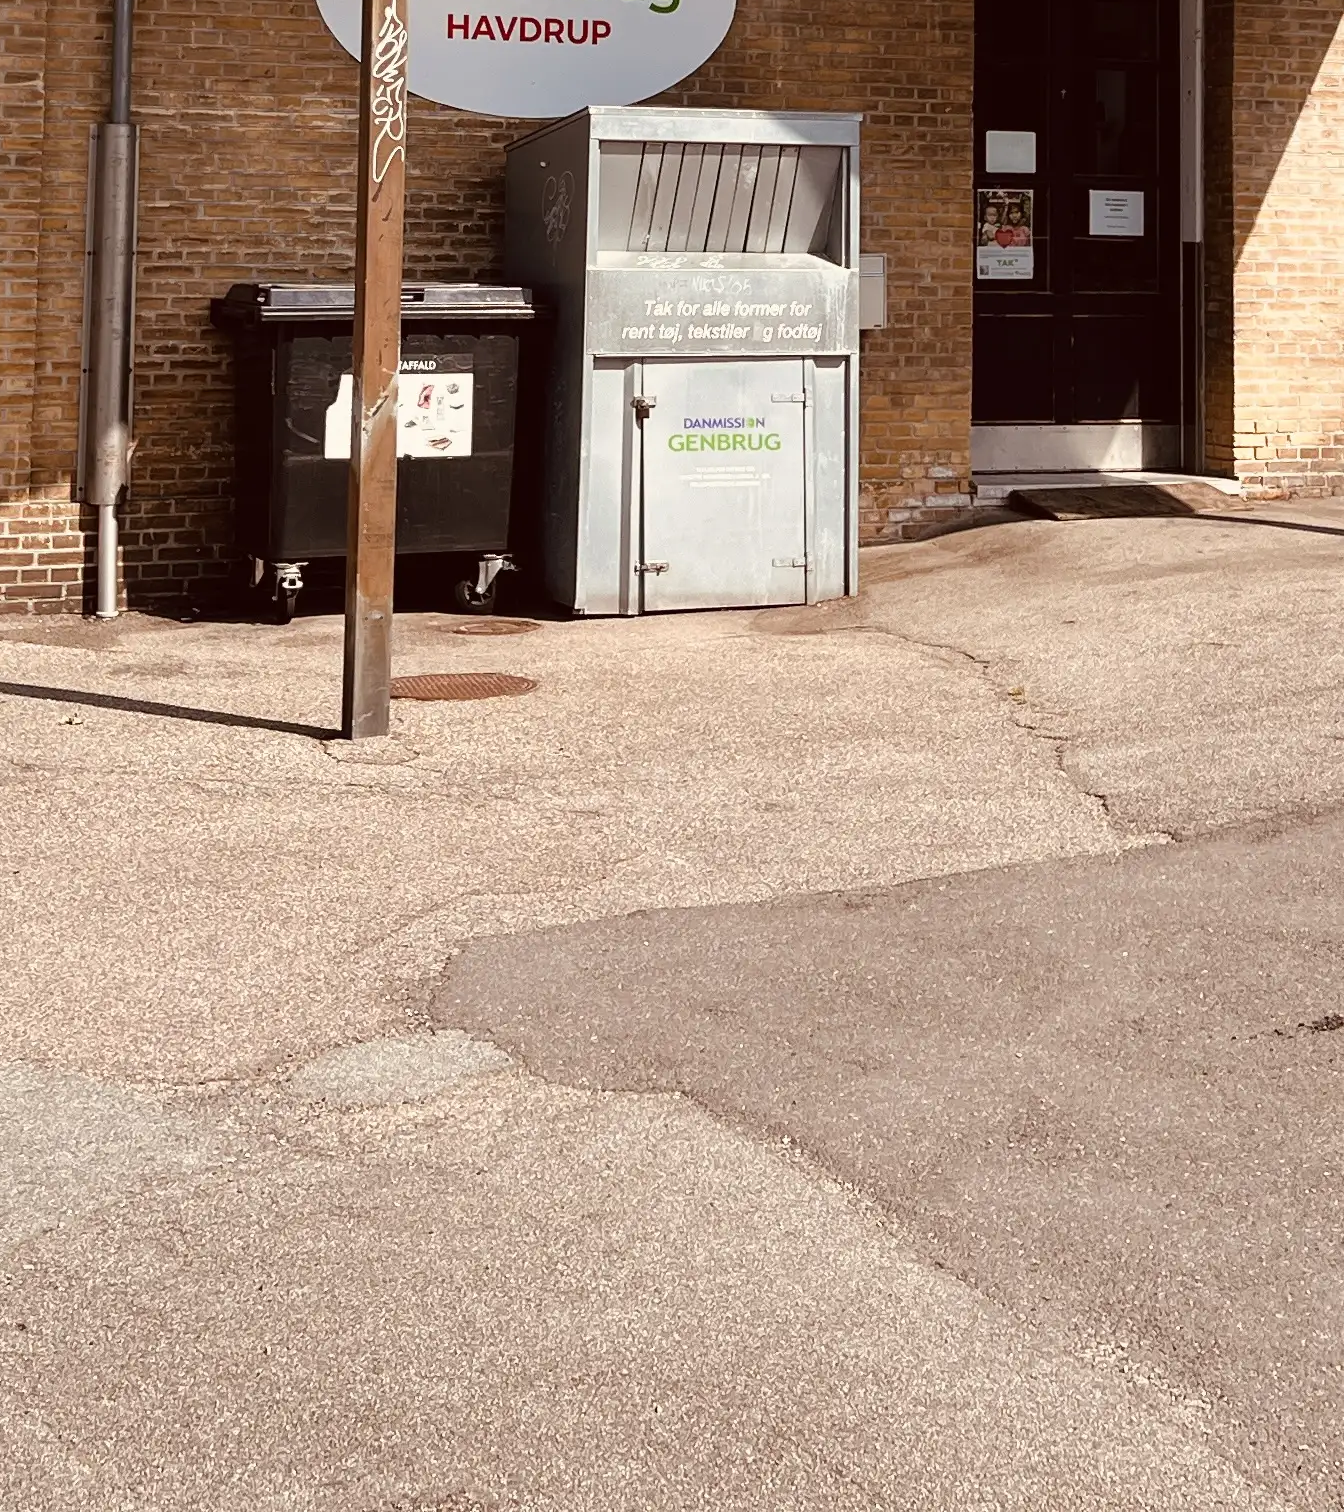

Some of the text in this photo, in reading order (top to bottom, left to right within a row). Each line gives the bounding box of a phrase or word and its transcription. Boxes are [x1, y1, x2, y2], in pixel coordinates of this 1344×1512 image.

[447, 14, 612, 45] HAVDRUP
[644, 299, 813, 317] Tak for alle former for
[621, 324, 655, 340] rent
[658, 323, 683, 344] tøj,
[687, 322, 751, 340] tekstiler
[777, 322, 823, 343] fodtøj
[667, 433, 782, 452] GENBRUG
